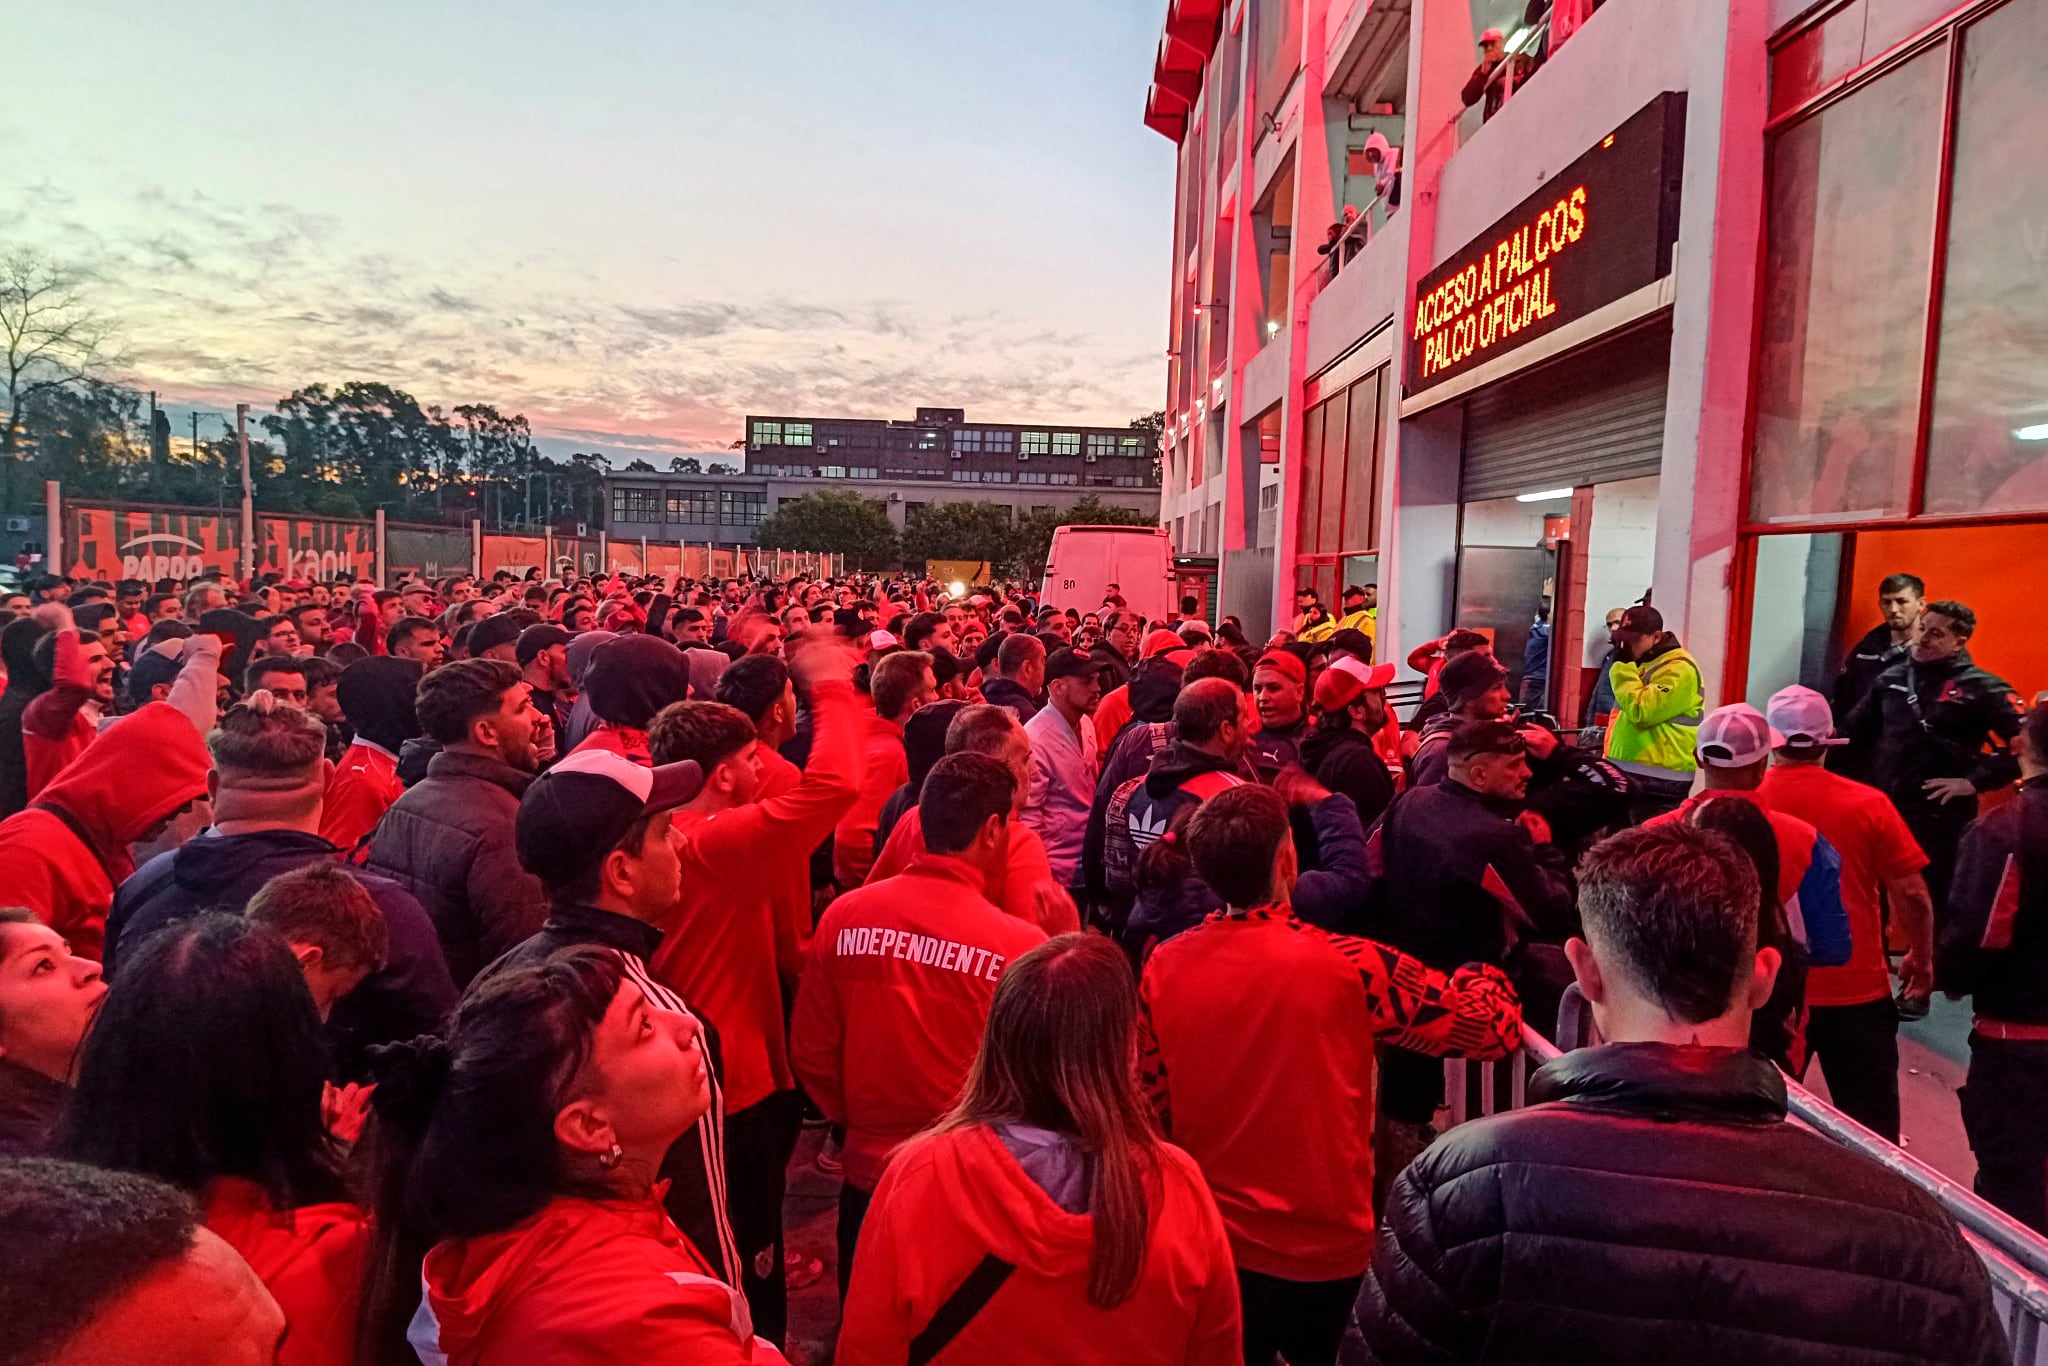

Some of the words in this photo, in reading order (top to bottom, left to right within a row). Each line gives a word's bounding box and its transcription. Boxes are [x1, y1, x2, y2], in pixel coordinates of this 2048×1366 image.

[1414, 264, 1476, 340] ACCESO
[1478, 253, 1492, 300] A
[1495, 186, 1586, 290] PALCOS
[1424, 313, 1476, 377] PALCO
[1479, 267, 1556, 348] OFICIAL
[122, 555, 203, 583] PARDO
[1063, 579, 1076, 590] 80
[836, 927, 1005, 982] INDEPENDIENTE
